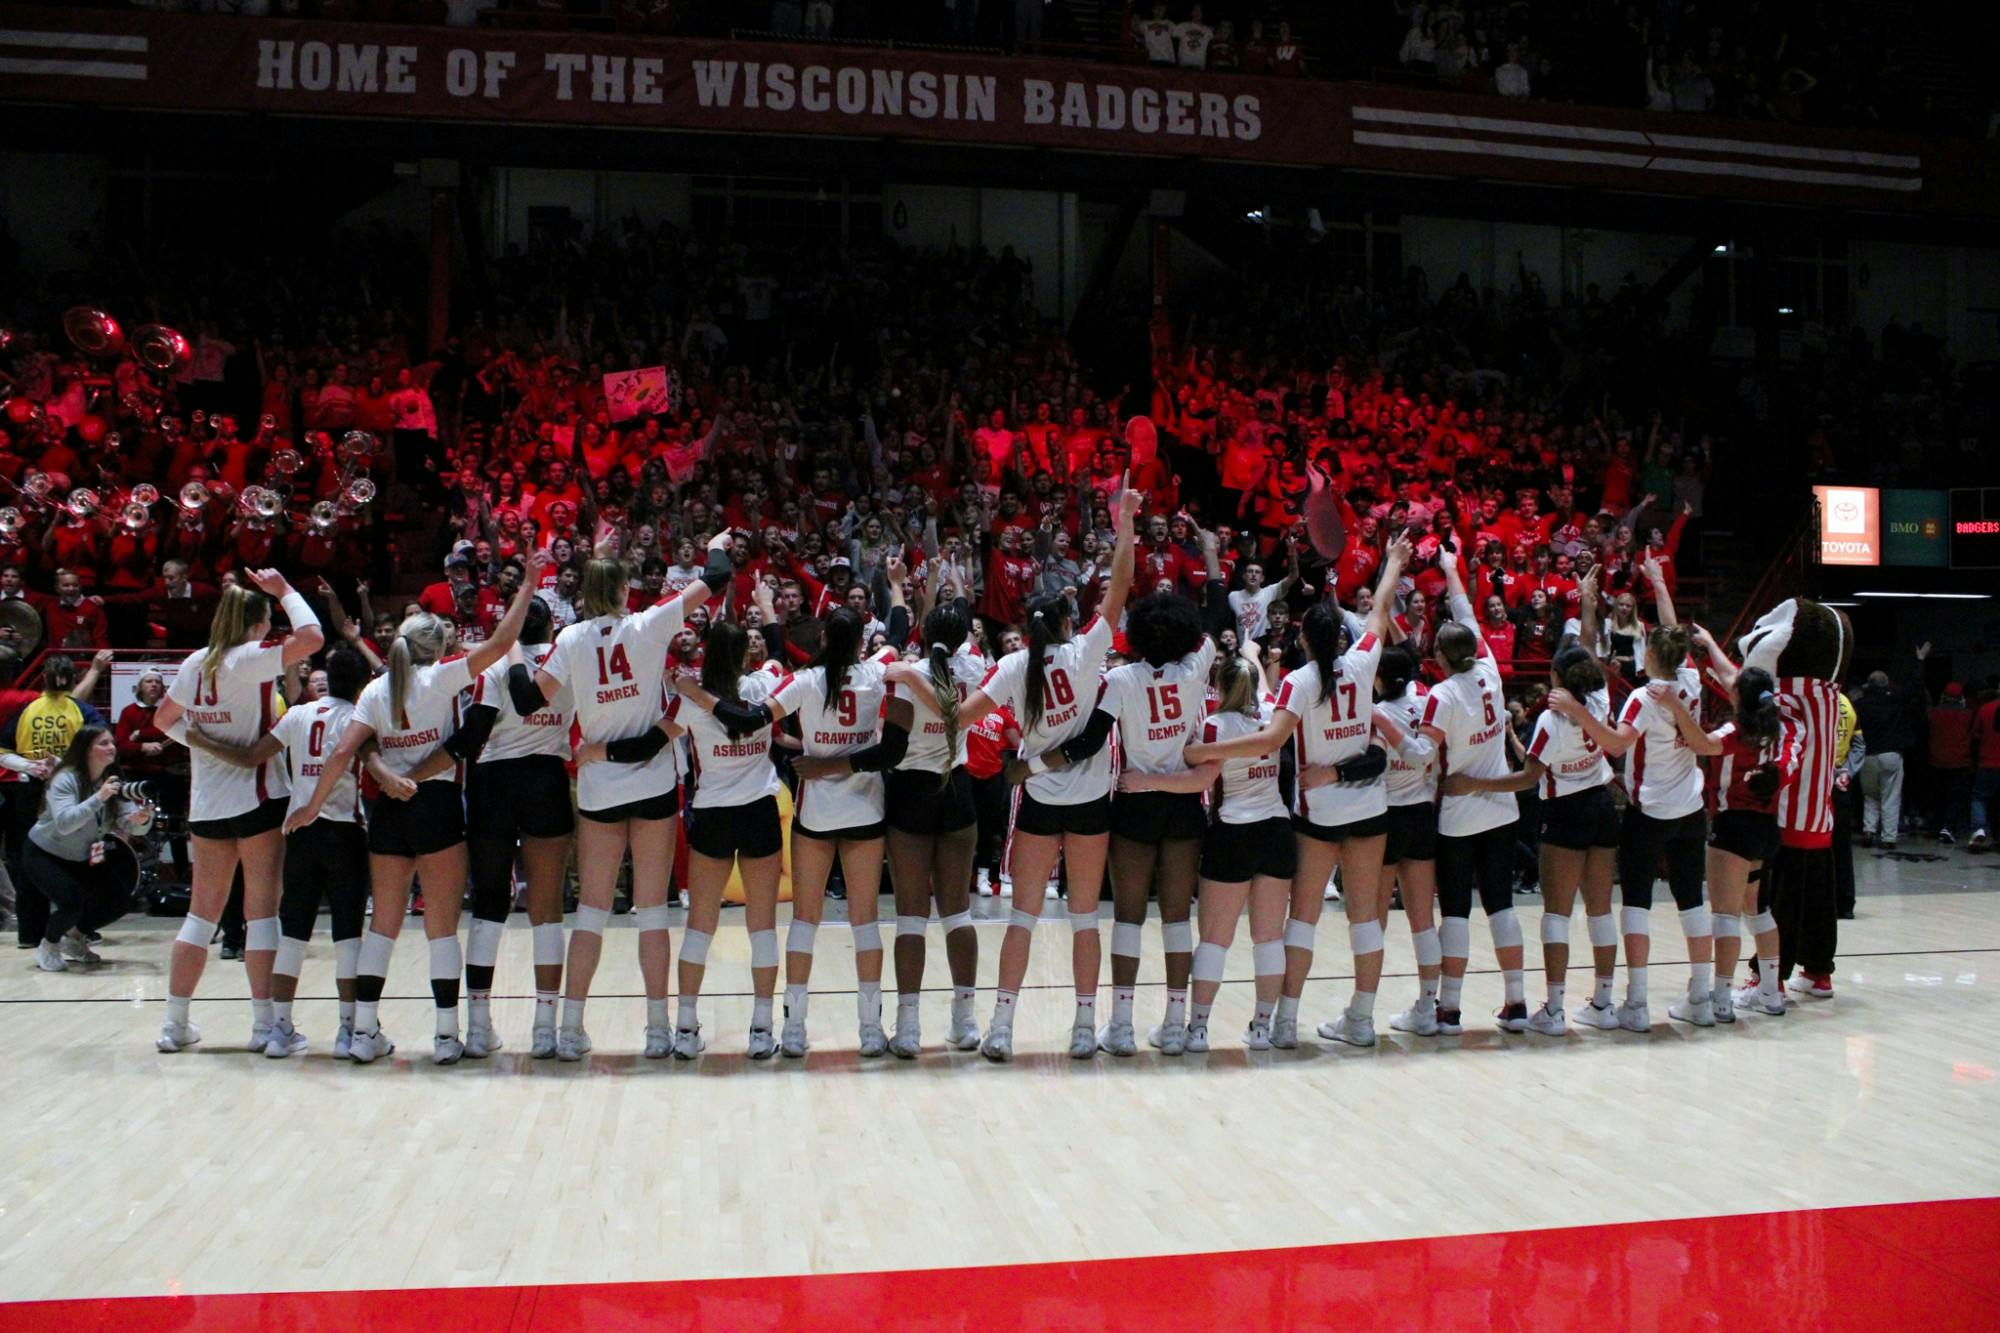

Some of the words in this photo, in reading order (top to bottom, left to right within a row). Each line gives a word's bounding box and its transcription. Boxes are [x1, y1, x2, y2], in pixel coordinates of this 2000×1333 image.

[257, 40, 418, 94] HOME
[446, 48, 516, 99] OF
[545, 53, 664, 104] THE
[694, 60, 997, 122] WISCONSIN
[1023, 79, 1263, 141] BADGERS
[1890, 522, 1919, 534] BMO
[1956, 522, 2000, 534] BADGERS
[1822, 541, 1871, 554] TOYOTA
[596, 643, 633, 685] 14
[596, 683, 640, 704] SMREK
[1043, 668, 1075, 710] 18
[839, 689, 857, 727] 9
[1146, 683, 1182, 724] 15
[1329, 682, 1357, 723] 17
[1482, 692, 1497, 726] 6
[32, 715, 67, 730] CSC
[523, 713, 562, 726] MCCAA
[1046, 704, 1078, 728] HART
[32, 730, 66, 746] EVENT
[309, 720, 326, 757] 0
[815, 730, 876, 745] CRAWFOR
[1148, 722, 1186, 741] DEMPS
[1324, 723, 1367, 741] WROBEL
[713, 741, 767, 757] ASHBURN
